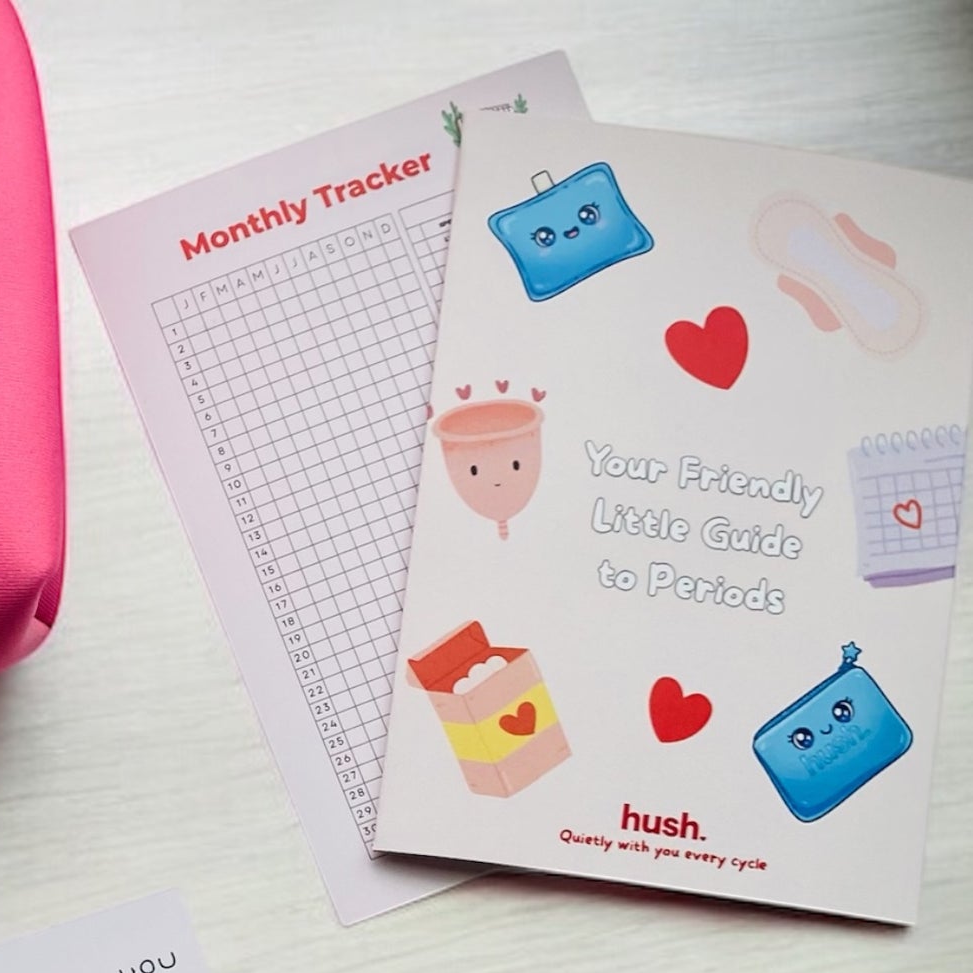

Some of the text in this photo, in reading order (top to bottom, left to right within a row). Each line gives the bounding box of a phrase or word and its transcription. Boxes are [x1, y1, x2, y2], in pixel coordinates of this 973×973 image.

[180, 153, 431, 260] Monthly Tracker
[199, 291, 207, 301] F
[216, 284, 228, 295] M
[236, 278, 245, 288] A
[252, 270, 265, 282] M
[309, 251, 318, 262] A
[326, 244, 335, 254] S
[344, 236, 356, 247] O
[362, 230, 373, 241] N
[380, 223, 391, 234] D
[172, 328, 177, 336] 1
[177, 344, 185, 354] 2
[184, 361, 192, 371] 3
[191, 379, 199, 387] 4
[197, 395, 205, 404] 5
[204, 413, 212, 421] 6
[210, 428, 217, 438] 7
[217, 446, 226, 456] 8
[224, 463, 232, 472] 9
[227, 479, 242, 491] 10
[584, 440, 824, 518] Your Friendly
[236, 497, 247, 507] 11
[241, 513, 255, 525] 12
[591, 498, 803, 560] Little Guide
[248, 530, 262, 542] 13
[255, 548, 268, 559] 14
[261, 565, 275, 577] 15
[268, 584, 282, 594] 16
[598, 559, 786, 615] to Periods
[275, 599, 287, 611] 17
[282, 616, 296, 628] 18
[288, 634, 301, 645] 19
[294, 650, 311, 663] 20
[302, 668, 316, 680] 21
[308, 685, 324, 698] 22
[315, 702, 331, 716] 23
[322, 720, 338, 733] 24
[328, 736, 345, 750] 25
[335, 754, 352, 767] 26
[342, 771, 357, 784] 27
[349, 788, 366, 801] 28
[356, 806, 372, 819] 29
[559, 829, 767, 871] Quietly with you every cycle
